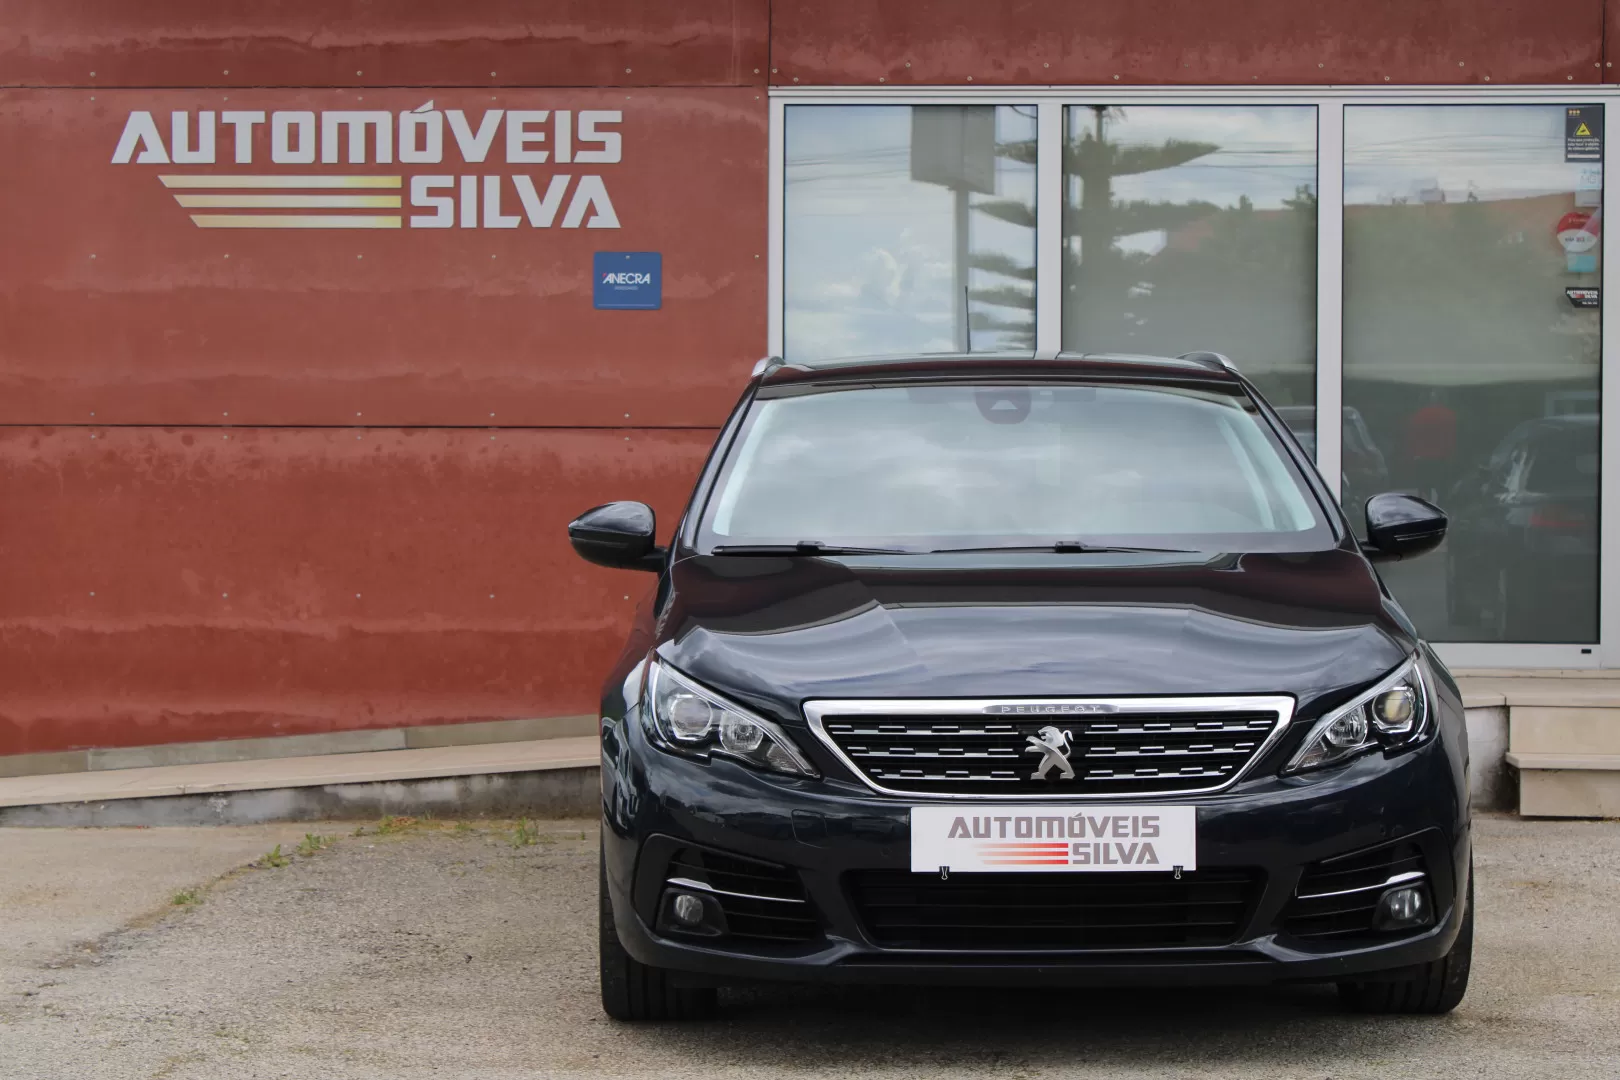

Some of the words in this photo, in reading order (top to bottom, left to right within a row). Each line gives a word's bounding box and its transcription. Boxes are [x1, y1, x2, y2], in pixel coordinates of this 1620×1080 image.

[111, 100, 622, 164] AUTOMÓVEIS
[410, 175, 621, 228] SILVA
[602, 272, 651, 284] ANECRA
[1001, 705, 1101, 713] PEUGEOT
[948, 812, 1160, 838] AUTOMÓVEIS
[1072, 843, 1160, 865] SILVA
